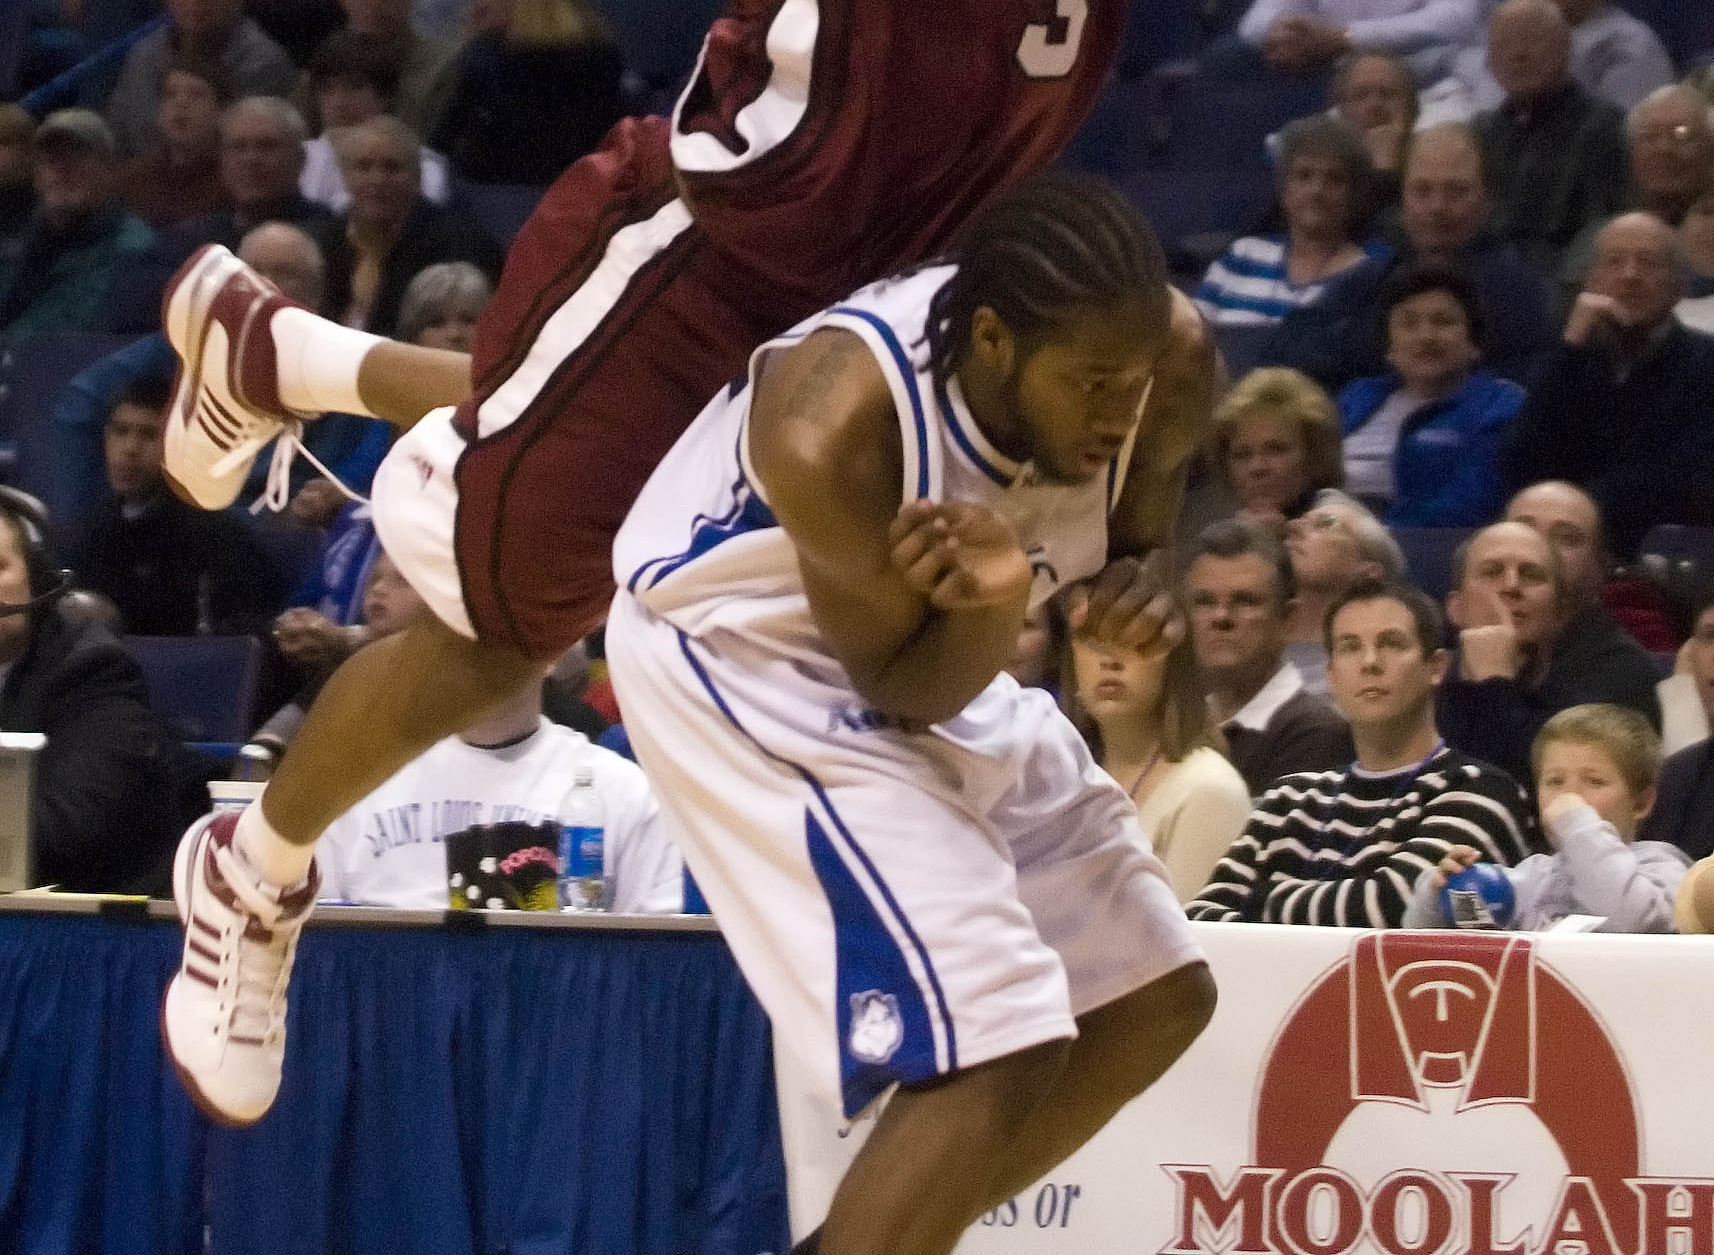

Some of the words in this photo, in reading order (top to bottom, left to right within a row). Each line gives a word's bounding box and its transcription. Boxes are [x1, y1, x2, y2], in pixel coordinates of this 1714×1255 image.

[365, 802, 421, 857] SAINT
[1035, 1183, 1081, 1228] or
[1157, 1163, 1714, 1255] MOOLAH
